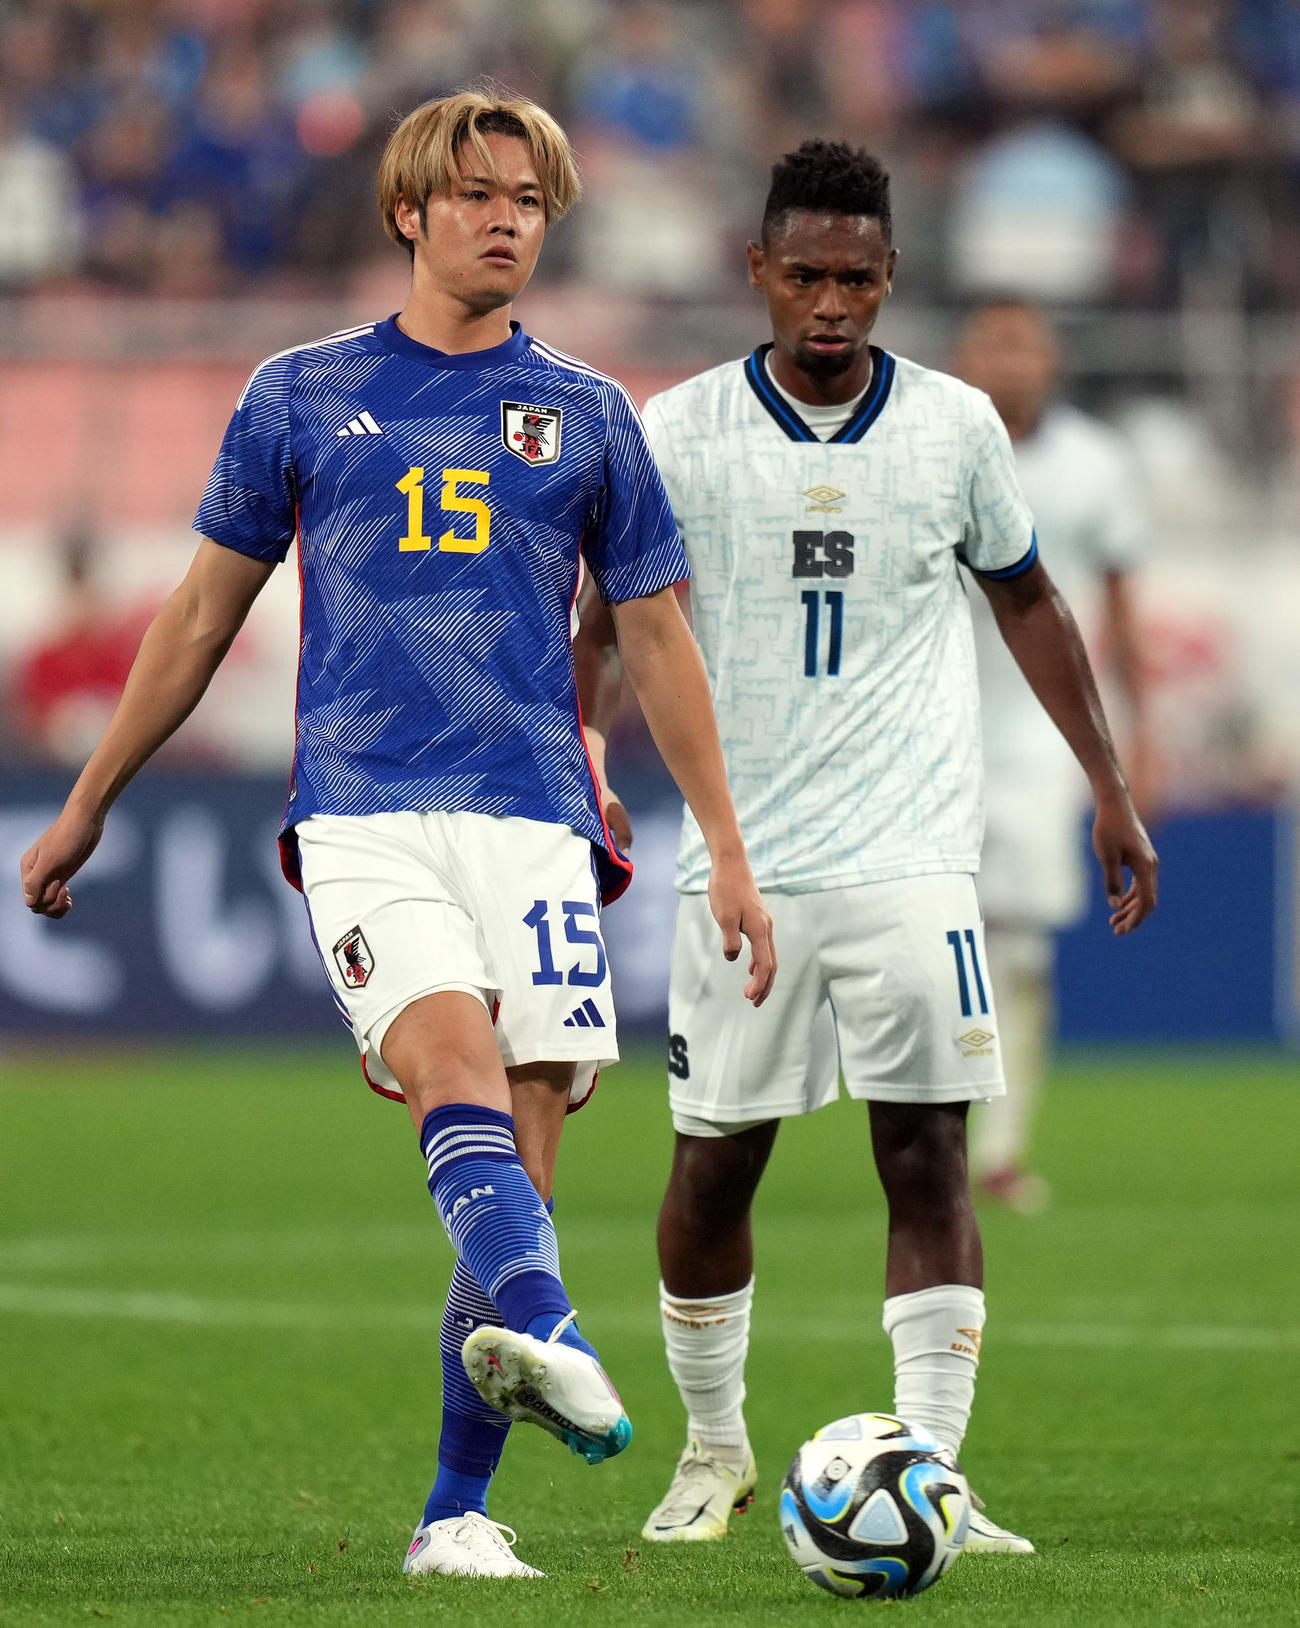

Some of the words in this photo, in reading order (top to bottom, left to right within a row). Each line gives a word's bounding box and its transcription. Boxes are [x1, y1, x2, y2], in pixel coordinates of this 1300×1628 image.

[516, 404, 548, 414] JAPAN
[518, 443, 544, 458] JFA
[395, 466, 492, 554] 15
[792, 530, 854, 579] ES
[801, 590, 844, 677] 11
[522, 900, 607, 988] 15
[946, 929, 989, 1018] 11
